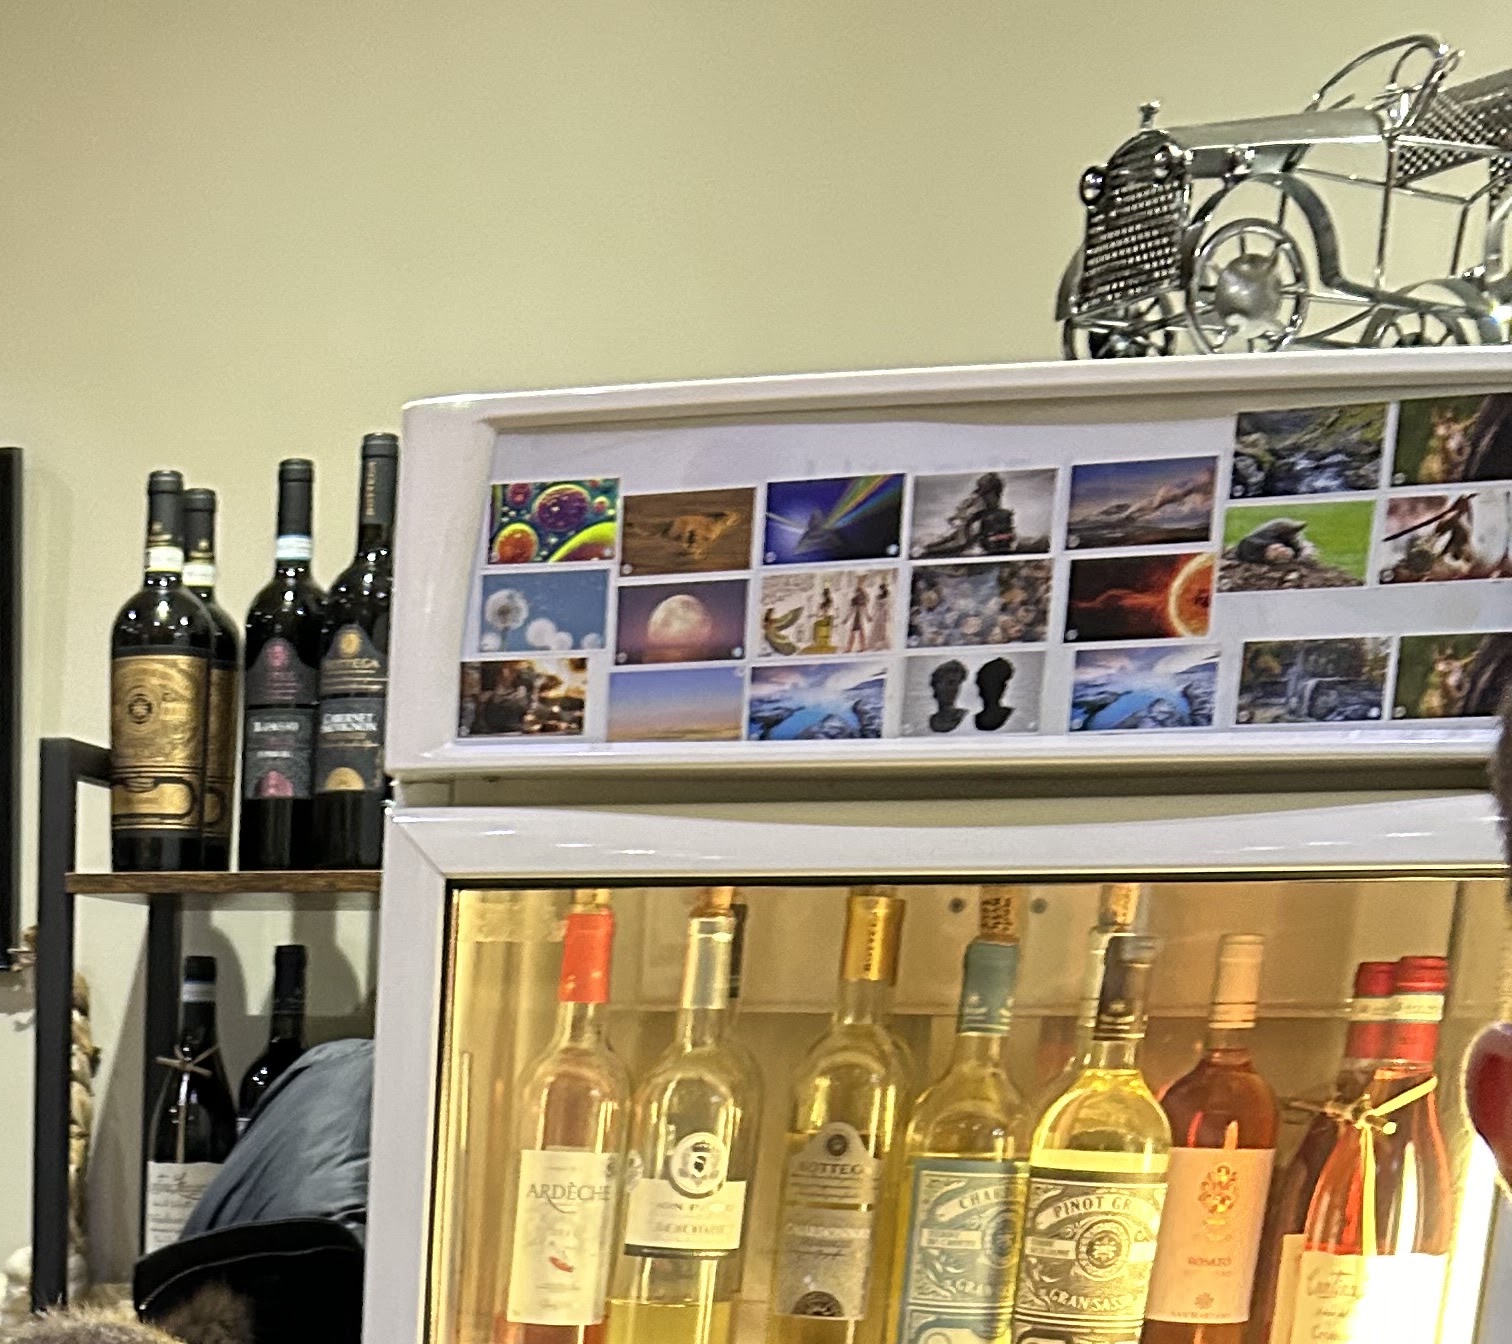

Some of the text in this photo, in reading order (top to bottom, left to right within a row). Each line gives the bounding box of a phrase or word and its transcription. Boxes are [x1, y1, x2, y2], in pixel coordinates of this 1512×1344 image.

[526, 1181, 611, 1209] ARDÈCHE
[1053, 1196, 1104, 1218] PINOT
[1049, 1290, 1088, 1310] GRAN
